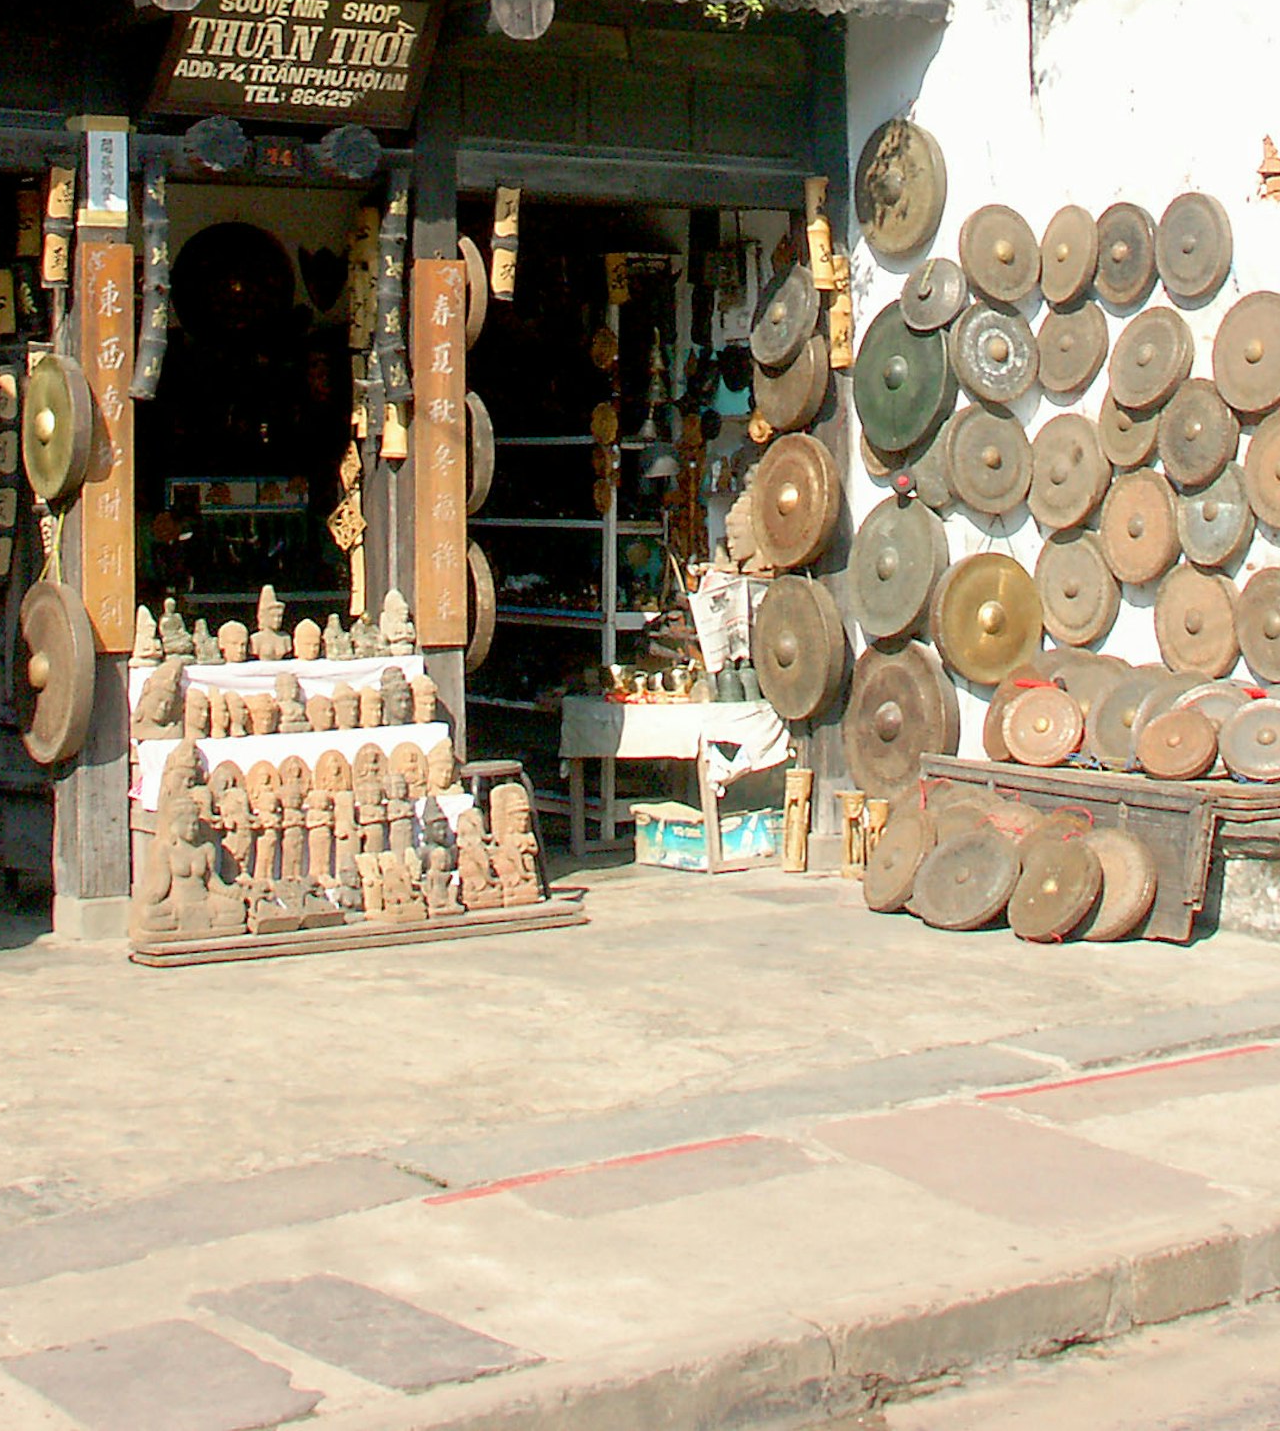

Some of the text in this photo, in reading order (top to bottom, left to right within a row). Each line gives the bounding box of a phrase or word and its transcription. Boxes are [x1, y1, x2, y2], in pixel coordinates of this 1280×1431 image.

[342, 1, 402, 25] SHOP
[187, 16, 324, 64] THUẬN
[244, 85, 286, 104] TEL:
